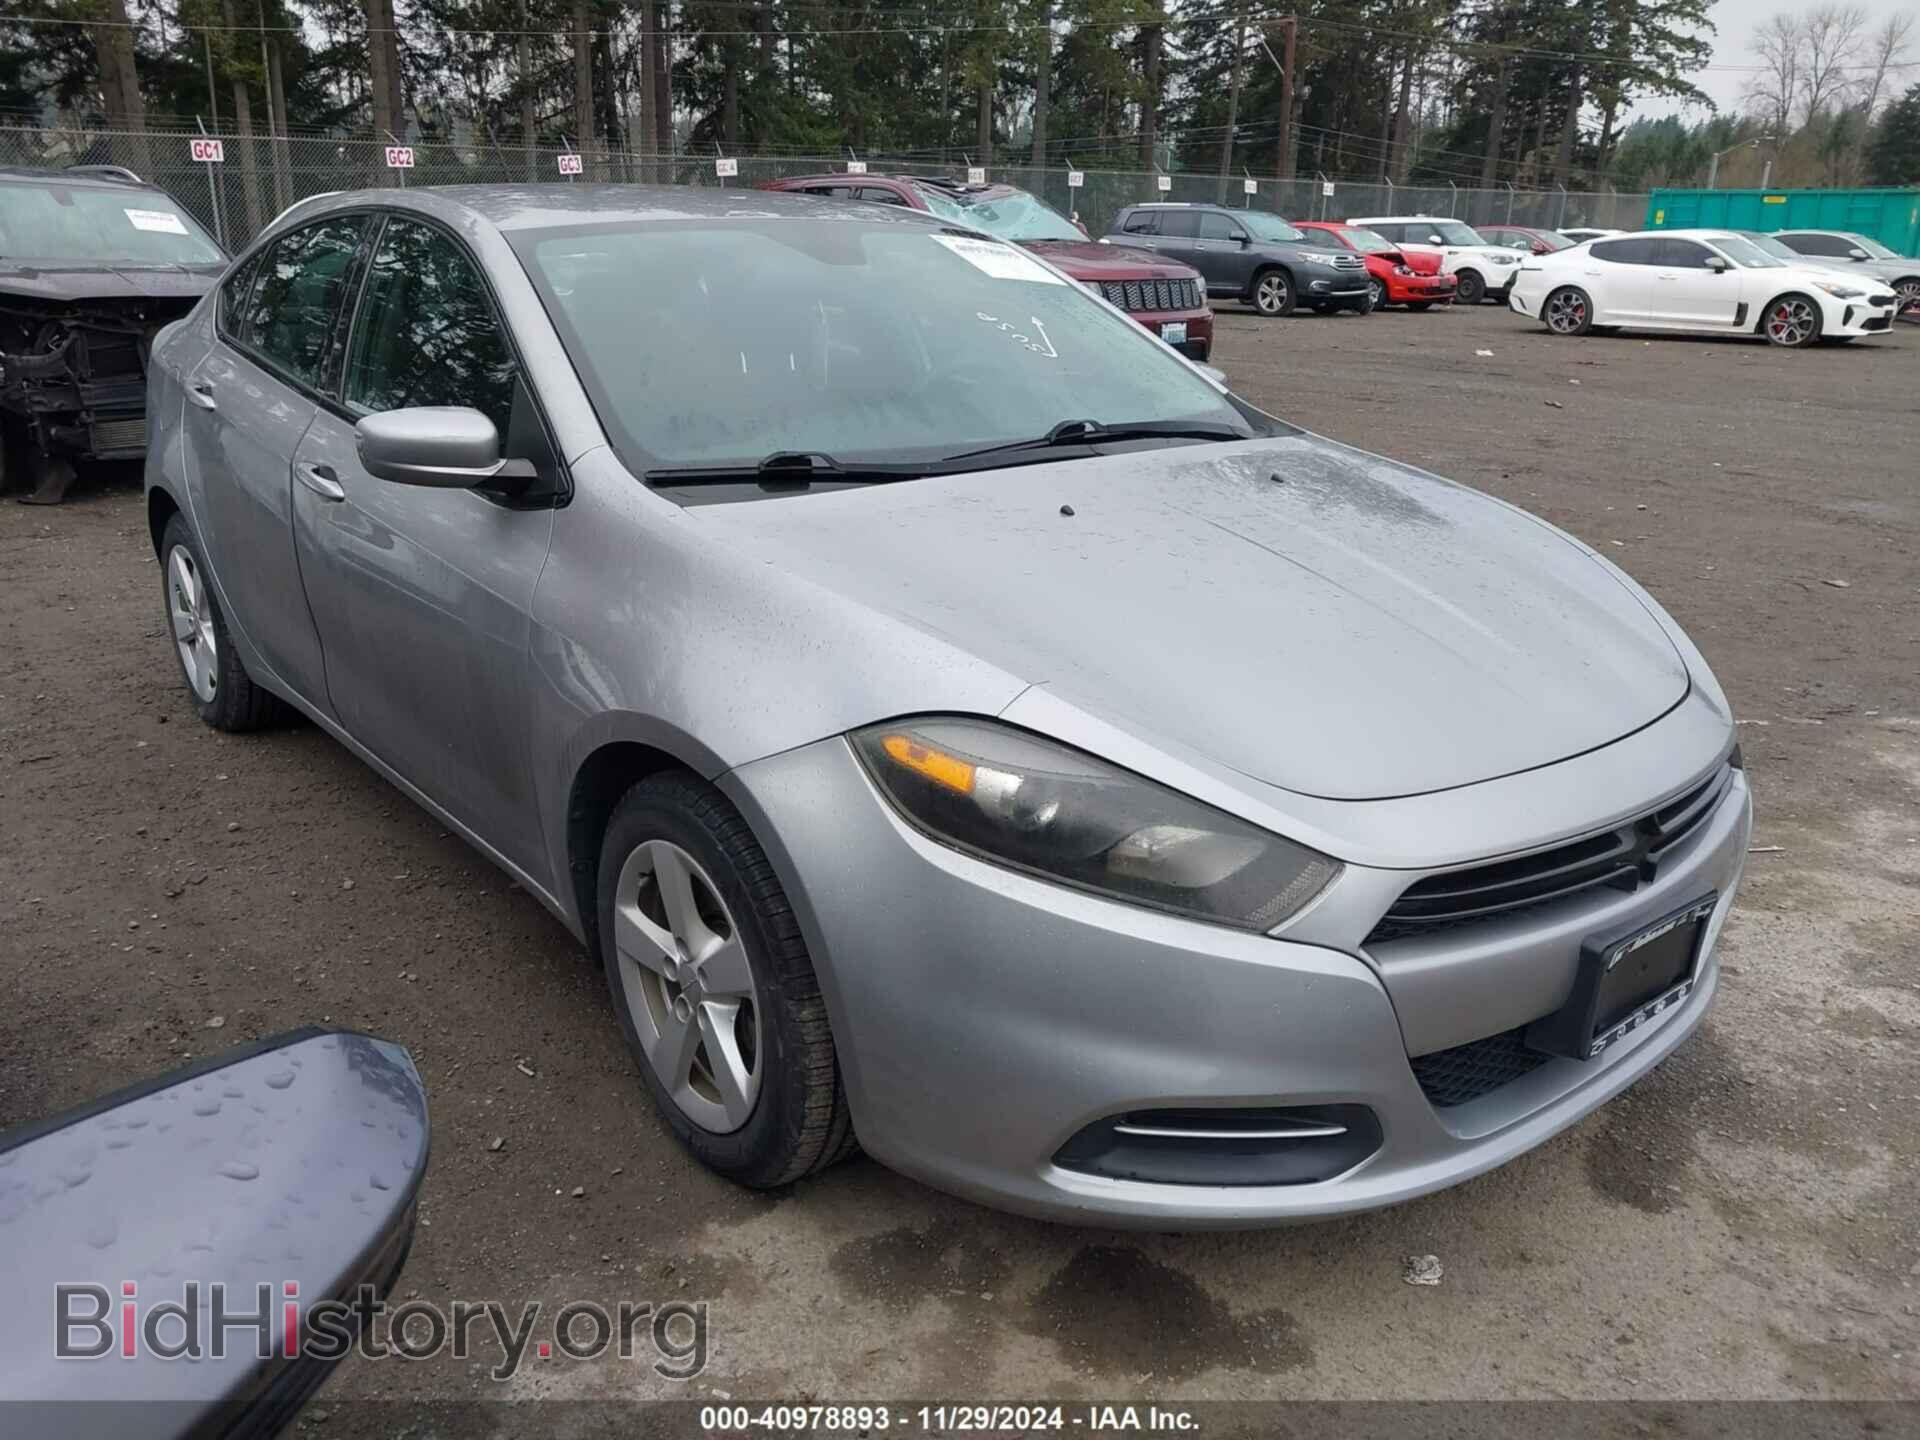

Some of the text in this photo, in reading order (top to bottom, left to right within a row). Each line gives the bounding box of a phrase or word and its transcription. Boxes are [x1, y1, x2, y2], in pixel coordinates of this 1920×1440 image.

[194, 142, 221, 160] GC1
[388, 149, 412, 165] GC2
[560, 157, 581, 172] GC3
